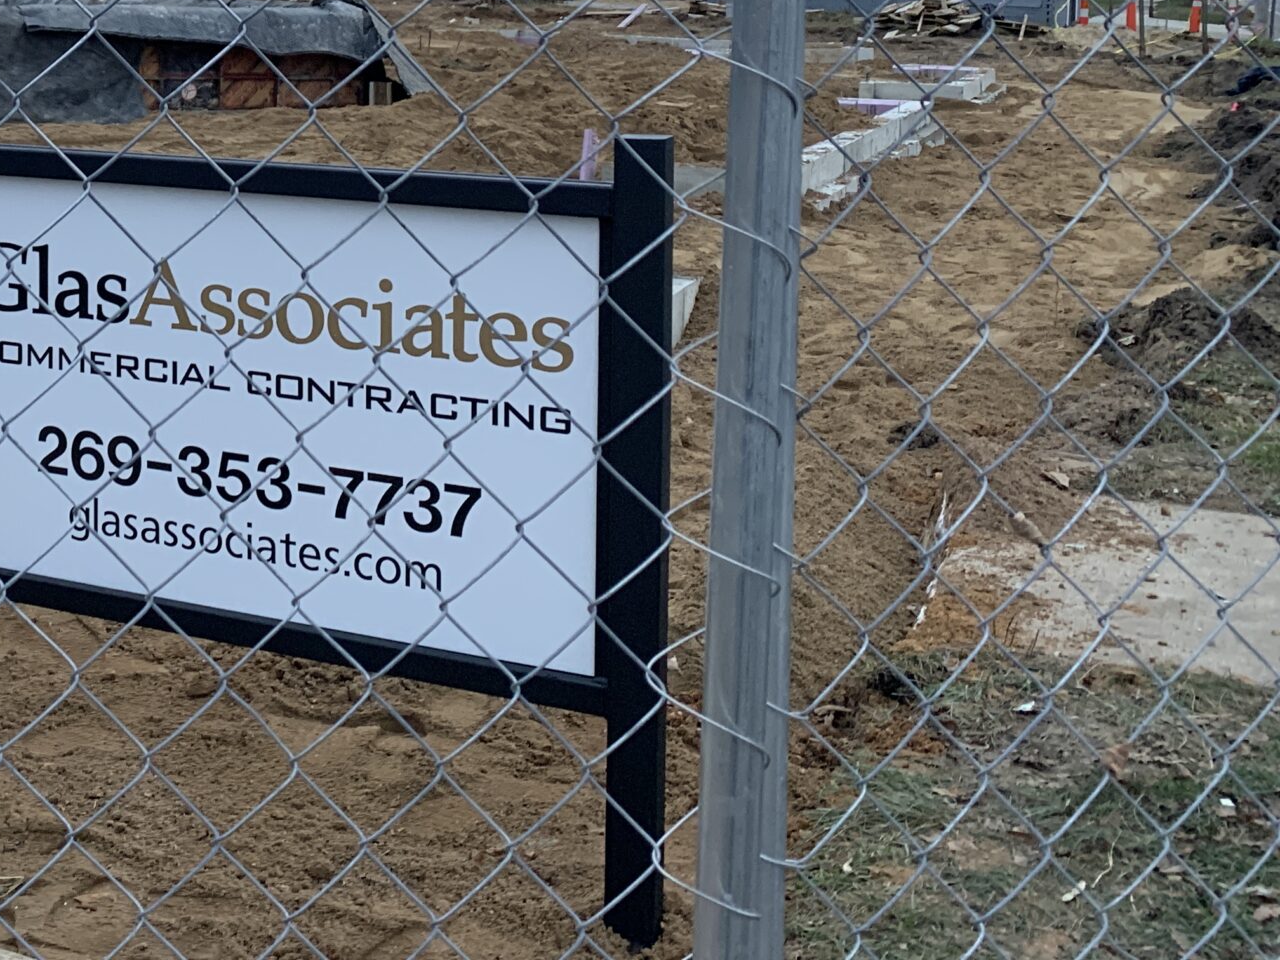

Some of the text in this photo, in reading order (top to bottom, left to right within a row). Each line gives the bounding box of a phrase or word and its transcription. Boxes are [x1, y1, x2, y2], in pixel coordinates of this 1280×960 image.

[246, 370, 571, 435] CONTRACTING
[38, 425, 482, 538] 269-353-7737
[69, 498, 443, 591] glasassociates.com
